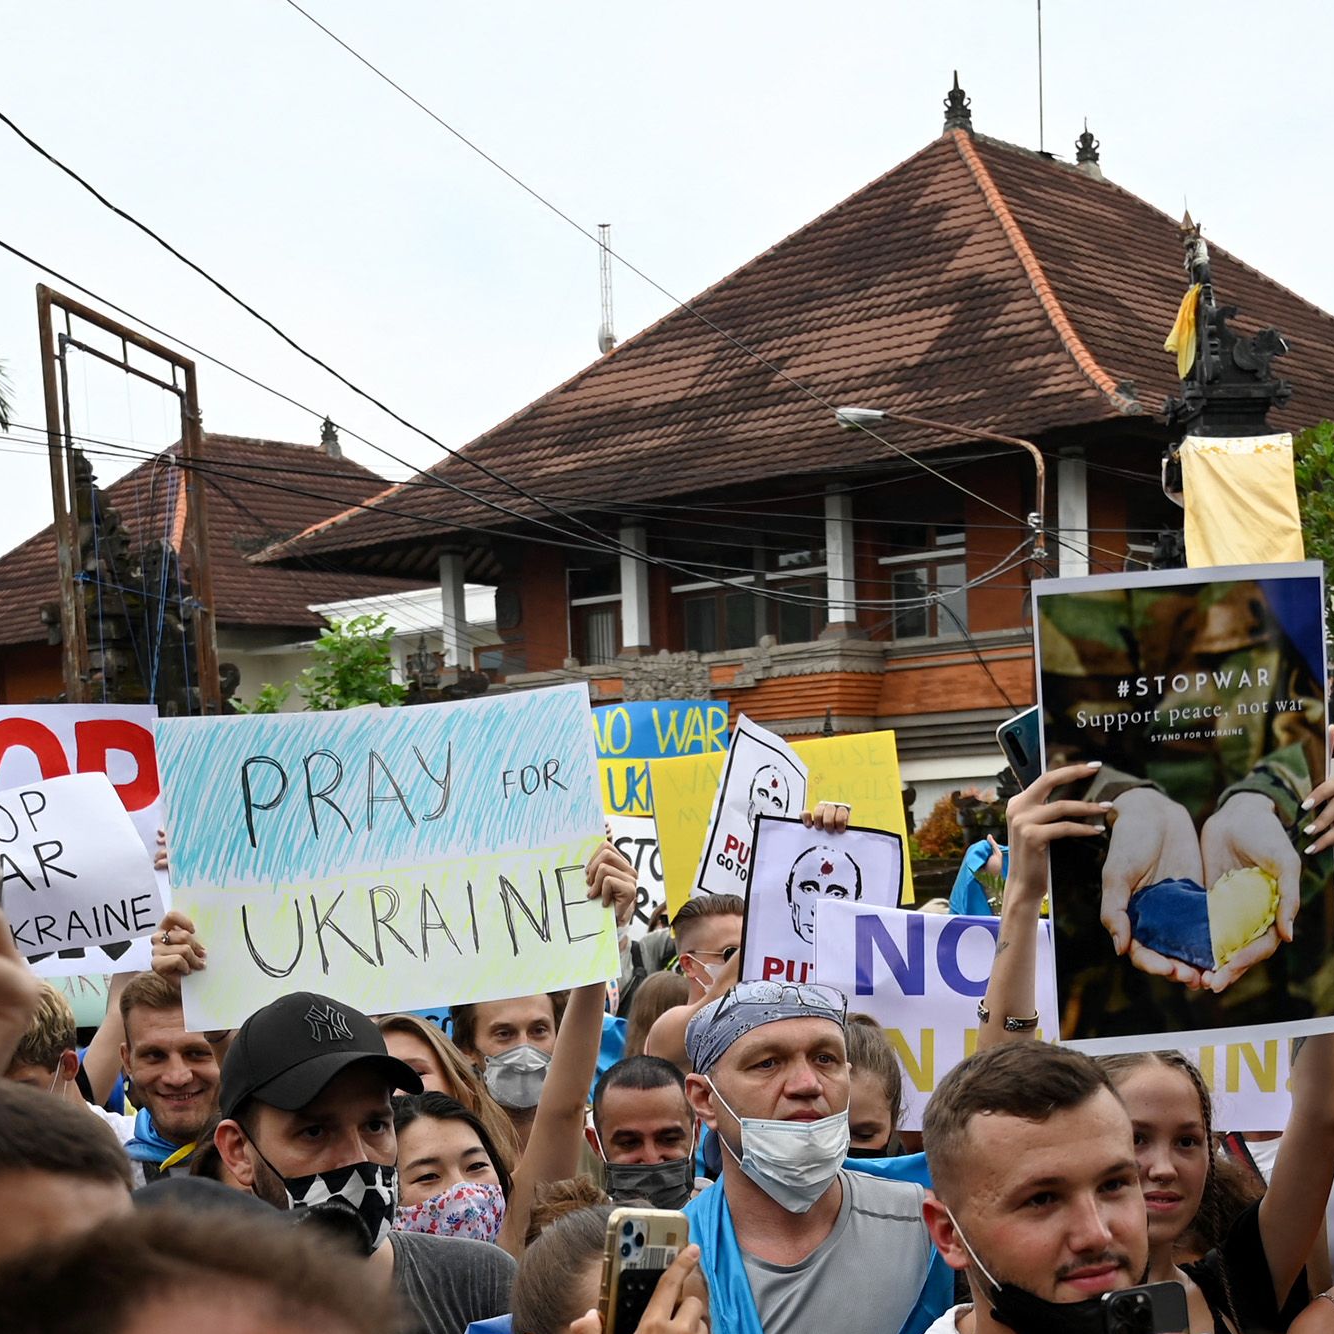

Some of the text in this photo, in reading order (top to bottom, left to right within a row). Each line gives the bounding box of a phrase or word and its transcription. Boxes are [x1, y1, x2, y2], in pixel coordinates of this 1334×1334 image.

[1117, 668, 1270, 698] #STOPWAR
[652, 706, 729, 753] WAR
[1076, 698, 1304, 732] Support peace, not war
[1151, 727, 1244, 743] STAND FOR UKRAINE
[242, 741, 568, 848] PRAY FOR
[0, 840, 78, 891] AR
[716, 853, 733, 871] GO
[10, 894, 156, 949] KRAINE
[242, 864, 605, 979] UKRAINE
